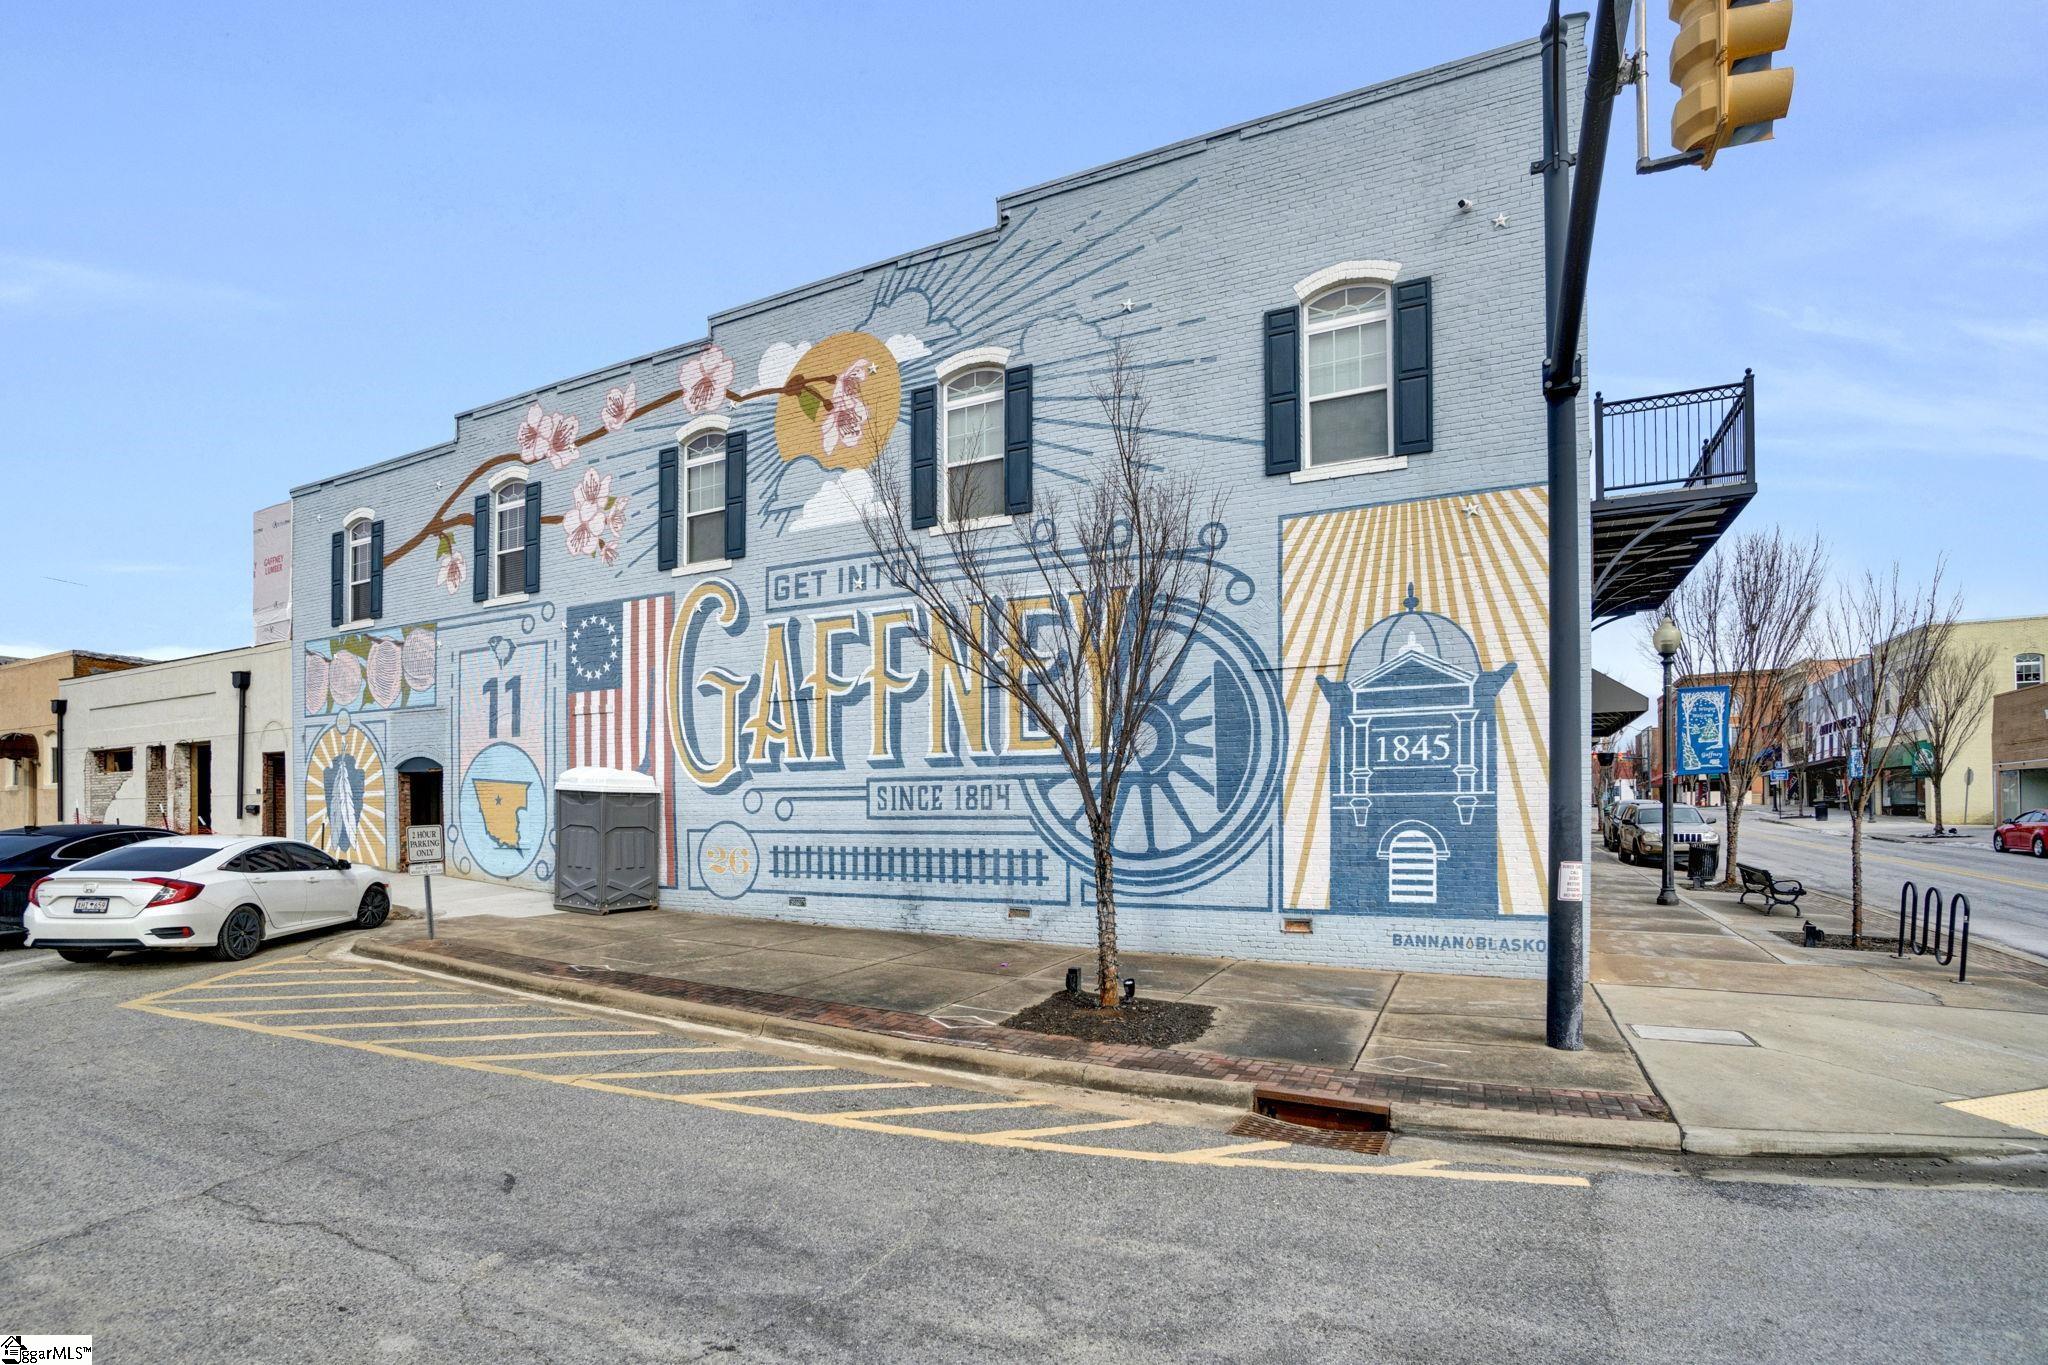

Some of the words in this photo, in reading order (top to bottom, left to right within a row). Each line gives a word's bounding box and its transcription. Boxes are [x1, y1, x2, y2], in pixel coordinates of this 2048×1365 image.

[263, 555, 284, 567] GAFFNEY
[264, 563, 283, 575] LUMBER
[774, 569, 827, 601] GET
[838, 559, 908, 594] INTO
[666, 577, 1134, 790] GAFFNEY
[482, 674, 521, 739] 11
[1376, 733, 1450, 763] 1845
[1701, 751, 1723, 759] Gaffney
[876, 784, 943, 811] SINCE
[953, 783, 1011, 811] 1804
[410, 840, 440, 848] PARKING
[416, 830, 437, 839] HOUR
[416, 849, 434, 857] ONLY
[707, 847, 750, 874] 26
[1392, 933, 1464, 950] BANNAN
[1475, 937, 1547, 953] BLASKO
